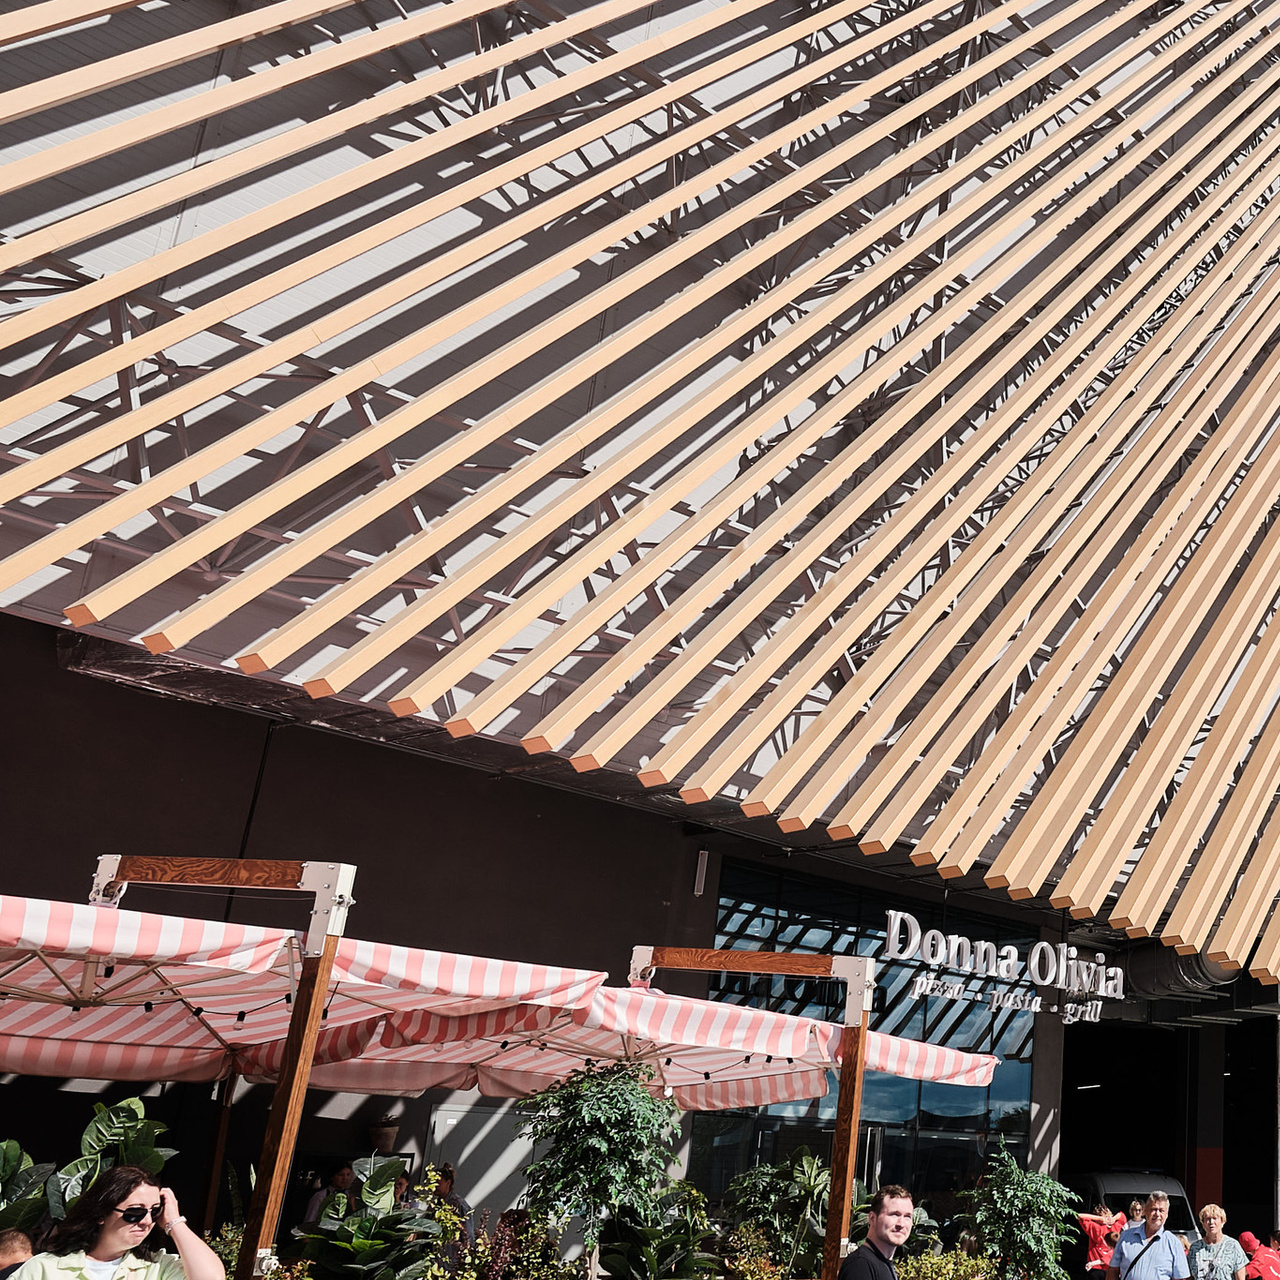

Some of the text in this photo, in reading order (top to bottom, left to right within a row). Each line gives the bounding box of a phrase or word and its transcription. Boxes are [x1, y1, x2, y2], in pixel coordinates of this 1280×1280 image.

[884, 909, 1125, 999] Donna Olivia
[909, 973, 967, 1000] pizza
[988, 989, 1042, 1013] pasta
[1062, 1000, 1104, 1024] grill
